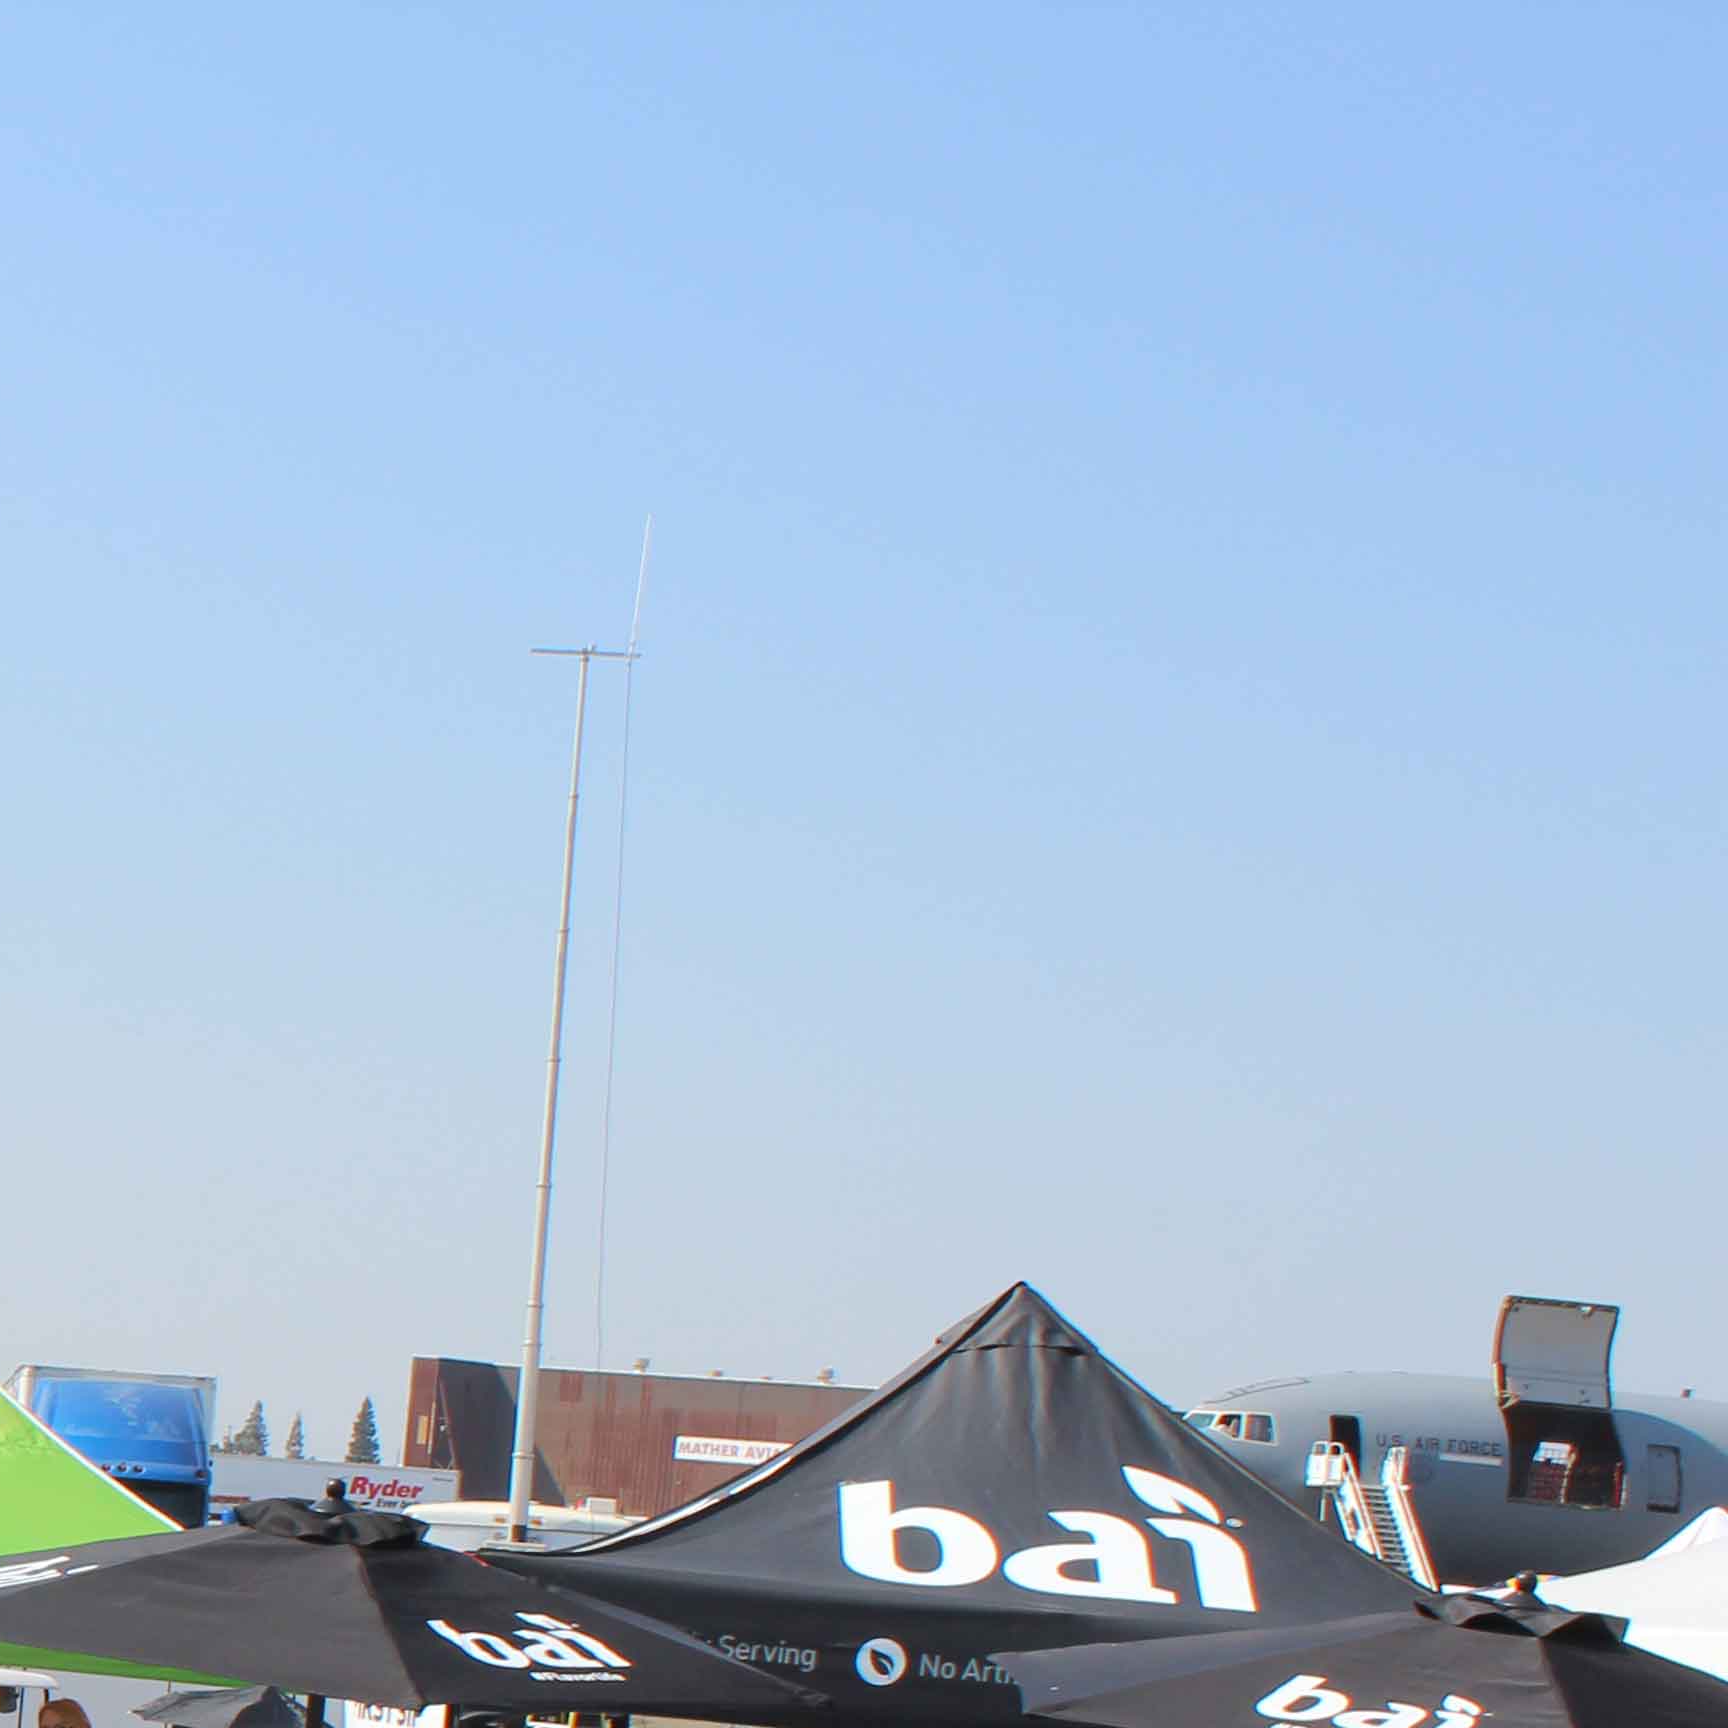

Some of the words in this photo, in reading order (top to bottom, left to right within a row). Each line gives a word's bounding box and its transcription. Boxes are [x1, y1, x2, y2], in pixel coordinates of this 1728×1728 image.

[350, 1476, 424, 1499] Ryder
[838, 1464, 1258, 1613] bai
[425, 1611, 634, 1668] bai
[717, 1634, 817, 1672] Serving
[919, 1654, 955, 1679] No
